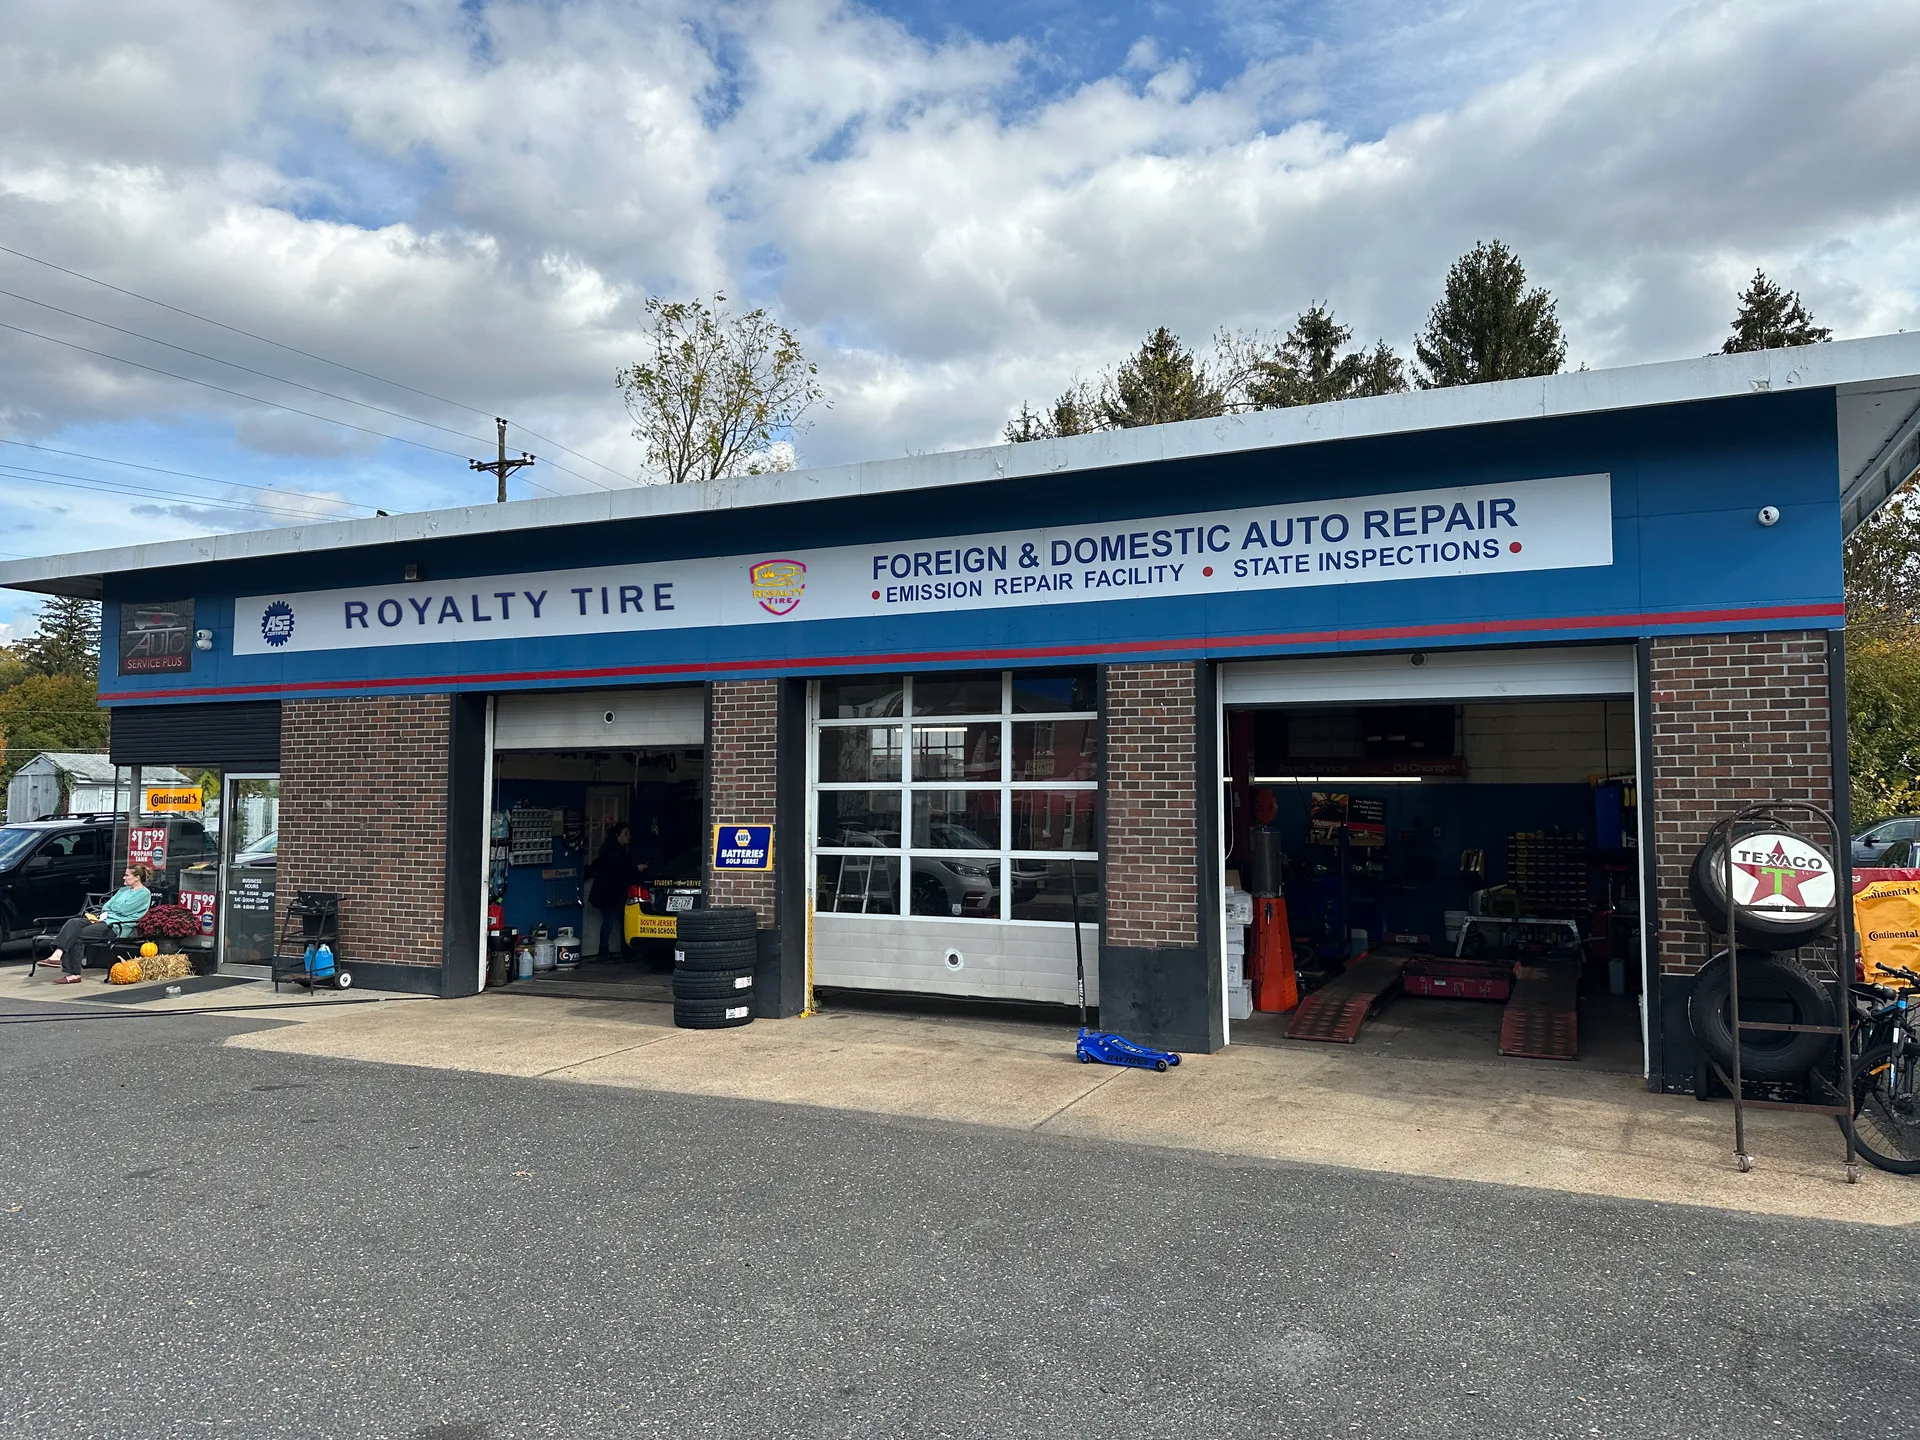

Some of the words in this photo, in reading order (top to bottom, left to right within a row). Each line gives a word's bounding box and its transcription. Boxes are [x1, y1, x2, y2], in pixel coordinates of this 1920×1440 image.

[873, 546, 1007, 580] FOREIGN
[1019, 542, 1040, 568] &
[1052, 524, 1230, 567] DOMESTIC
[1241, 513, 1349, 550] AUTO
[1364, 497, 1518, 540] REPAIR
[1234, 554, 1309, 578] STATE
[1319, 539, 1500, 571] INSPECTIONS
[886, 580, 981, 603] EMISSION
[994, 573, 1073, 595] REPAIR
[1084, 564, 1184, 588] FACILITY
[753, 588, 804, 598] ROYALTY
[345, 590, 548, 629] ROYALTY
[571, 583, 676, 616] TIRE
[265, 615, 290, 632] ASE
[127, 658, 160, 669] SERVICE
[162, 657, 182, 668] PLUS
[1309, 764, 1348, 773] Service
[1393, 764, 1408, 772] Oil
[1409, 763, 1456, 774] Changes
[151, 794, 190, 806] Continental
[721, 849, 764, 858] BATTERIES
[1738, 850, 1822, 869] TEXACO
[1762, 867, 1795, 894] T
[1869, 930, 1918, 941] Continental
[1108, 1054, 1148, 1065] DAYTONA
